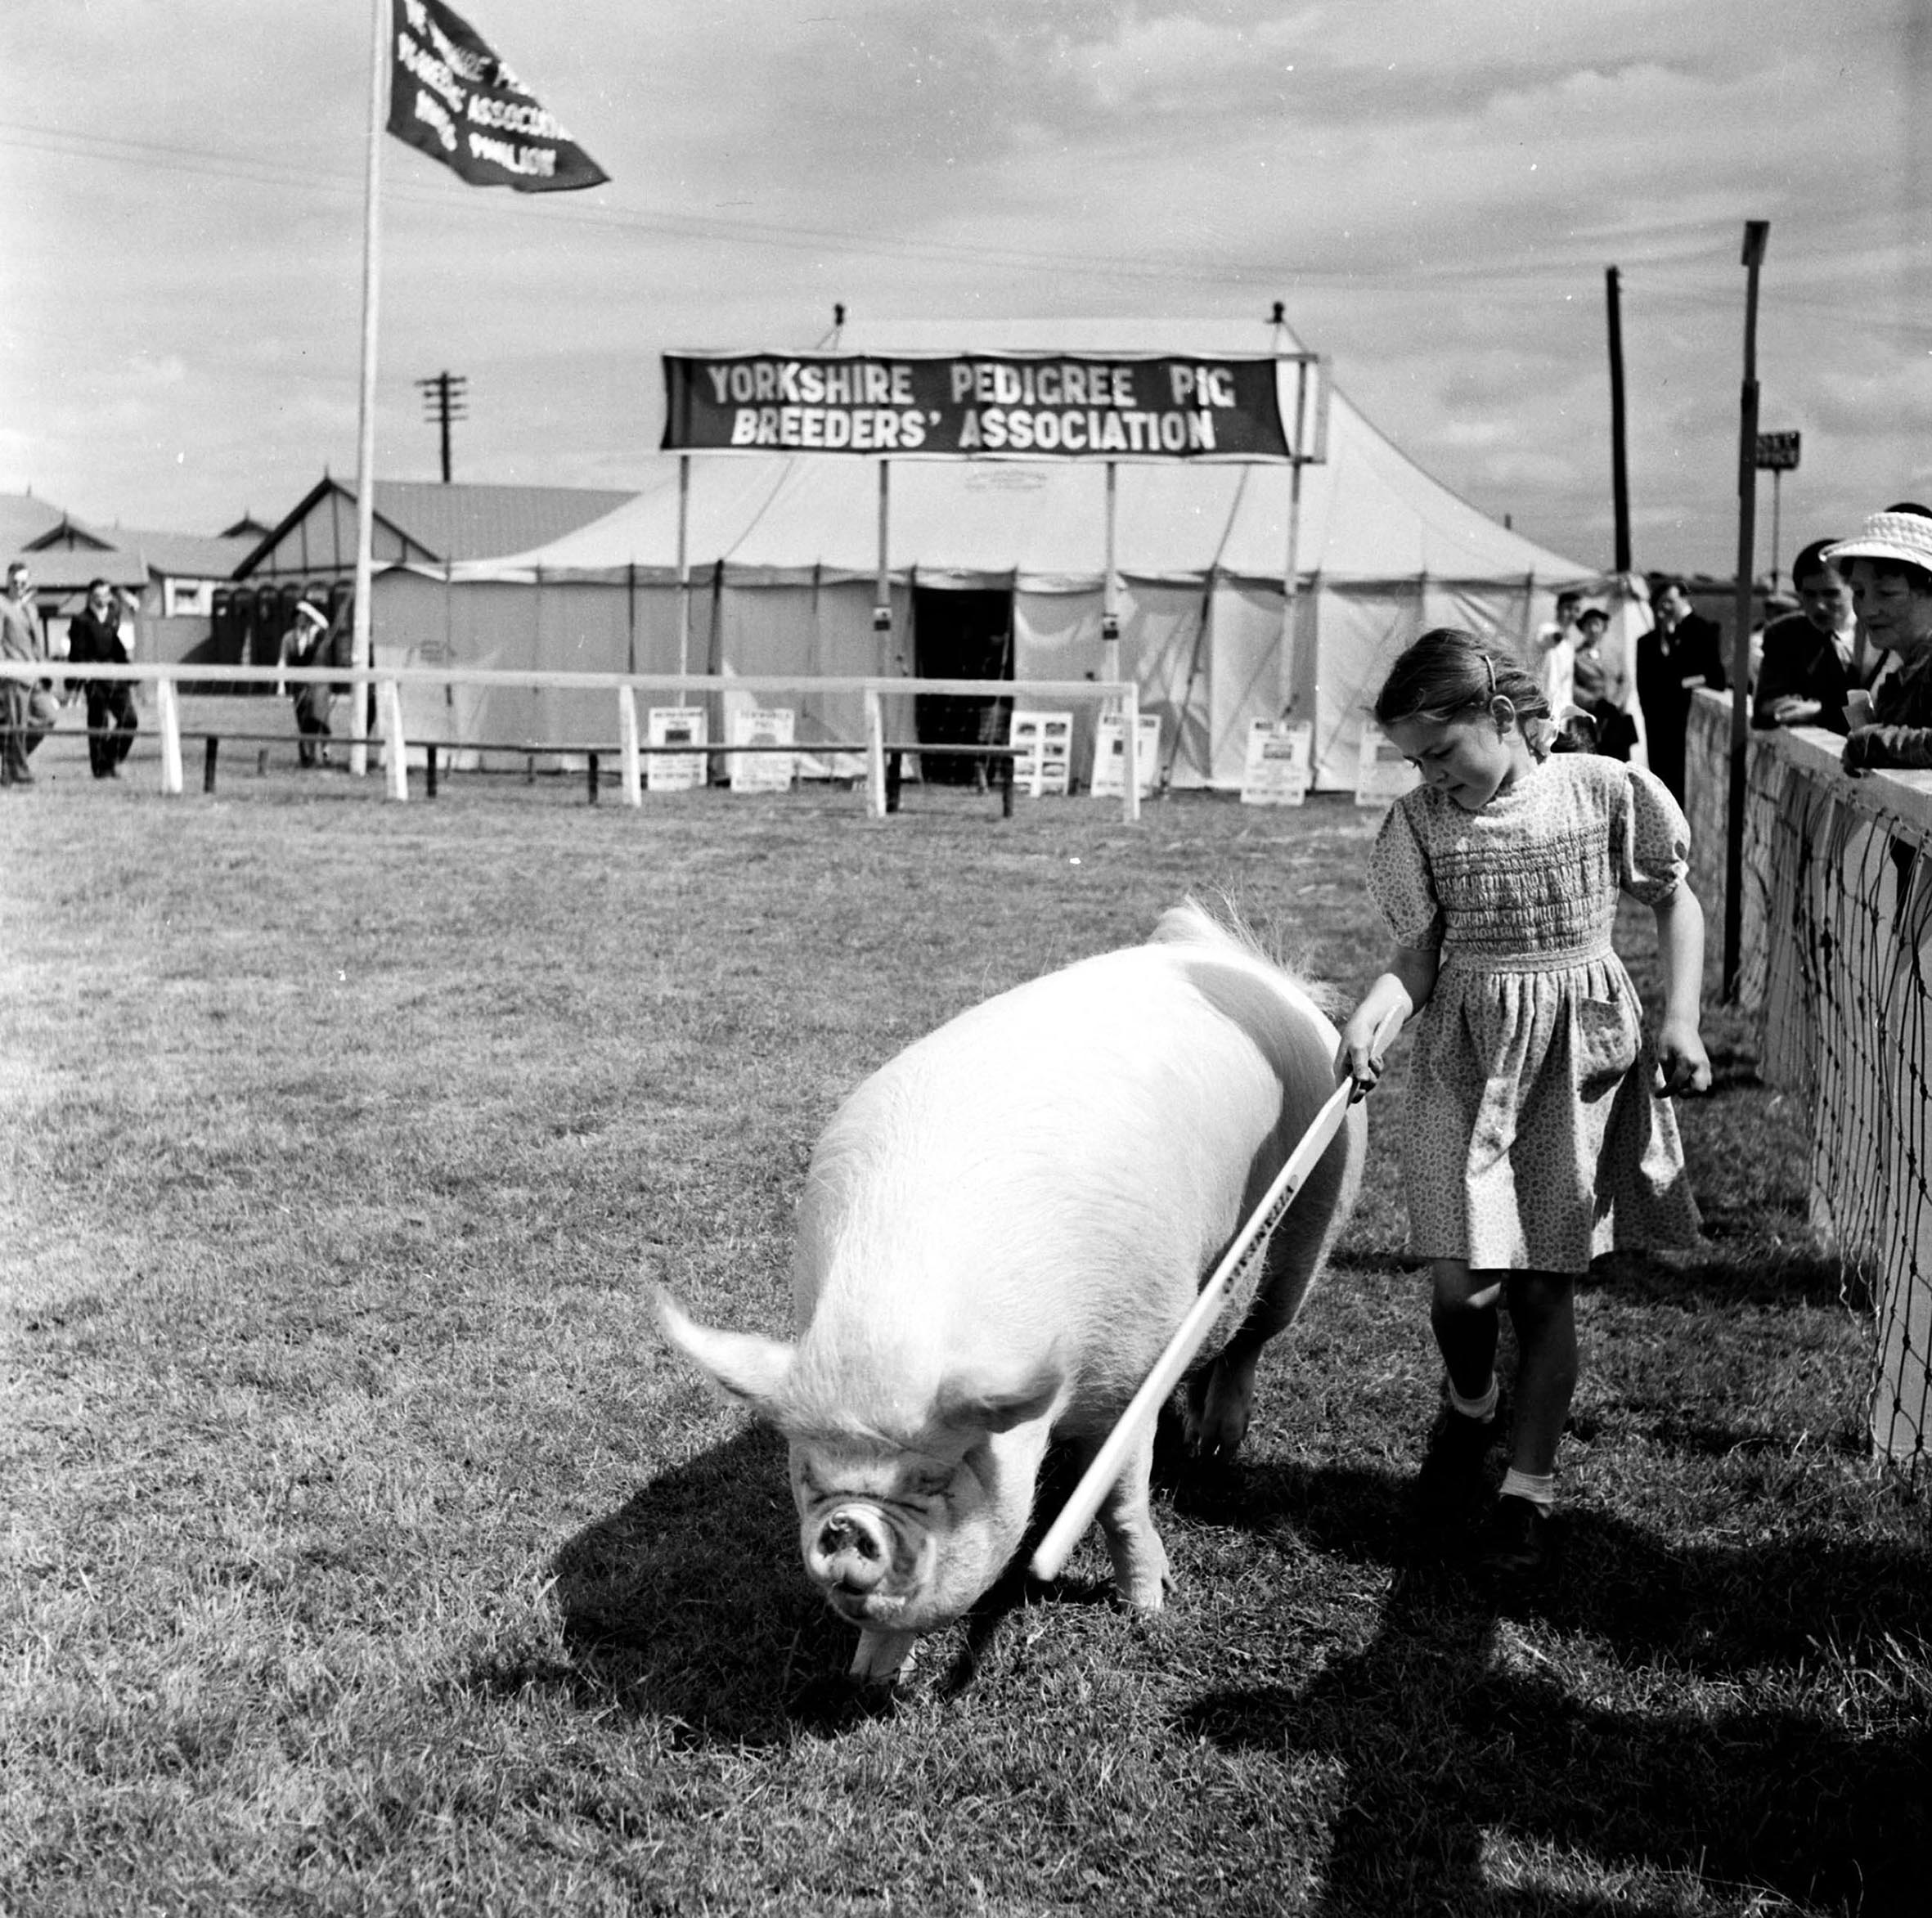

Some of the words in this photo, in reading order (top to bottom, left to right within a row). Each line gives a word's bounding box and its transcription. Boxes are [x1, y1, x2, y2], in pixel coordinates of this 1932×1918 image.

[708, 362, 914, 405] YORKSHIRE
[950, 364, 1137, 407] PEDIGREE
[1170, 366, 1236, 408] PIG
[731, 407, 941, 448] BREEDERS'
[959, 409, 1216, 451] ASSOCIATION
